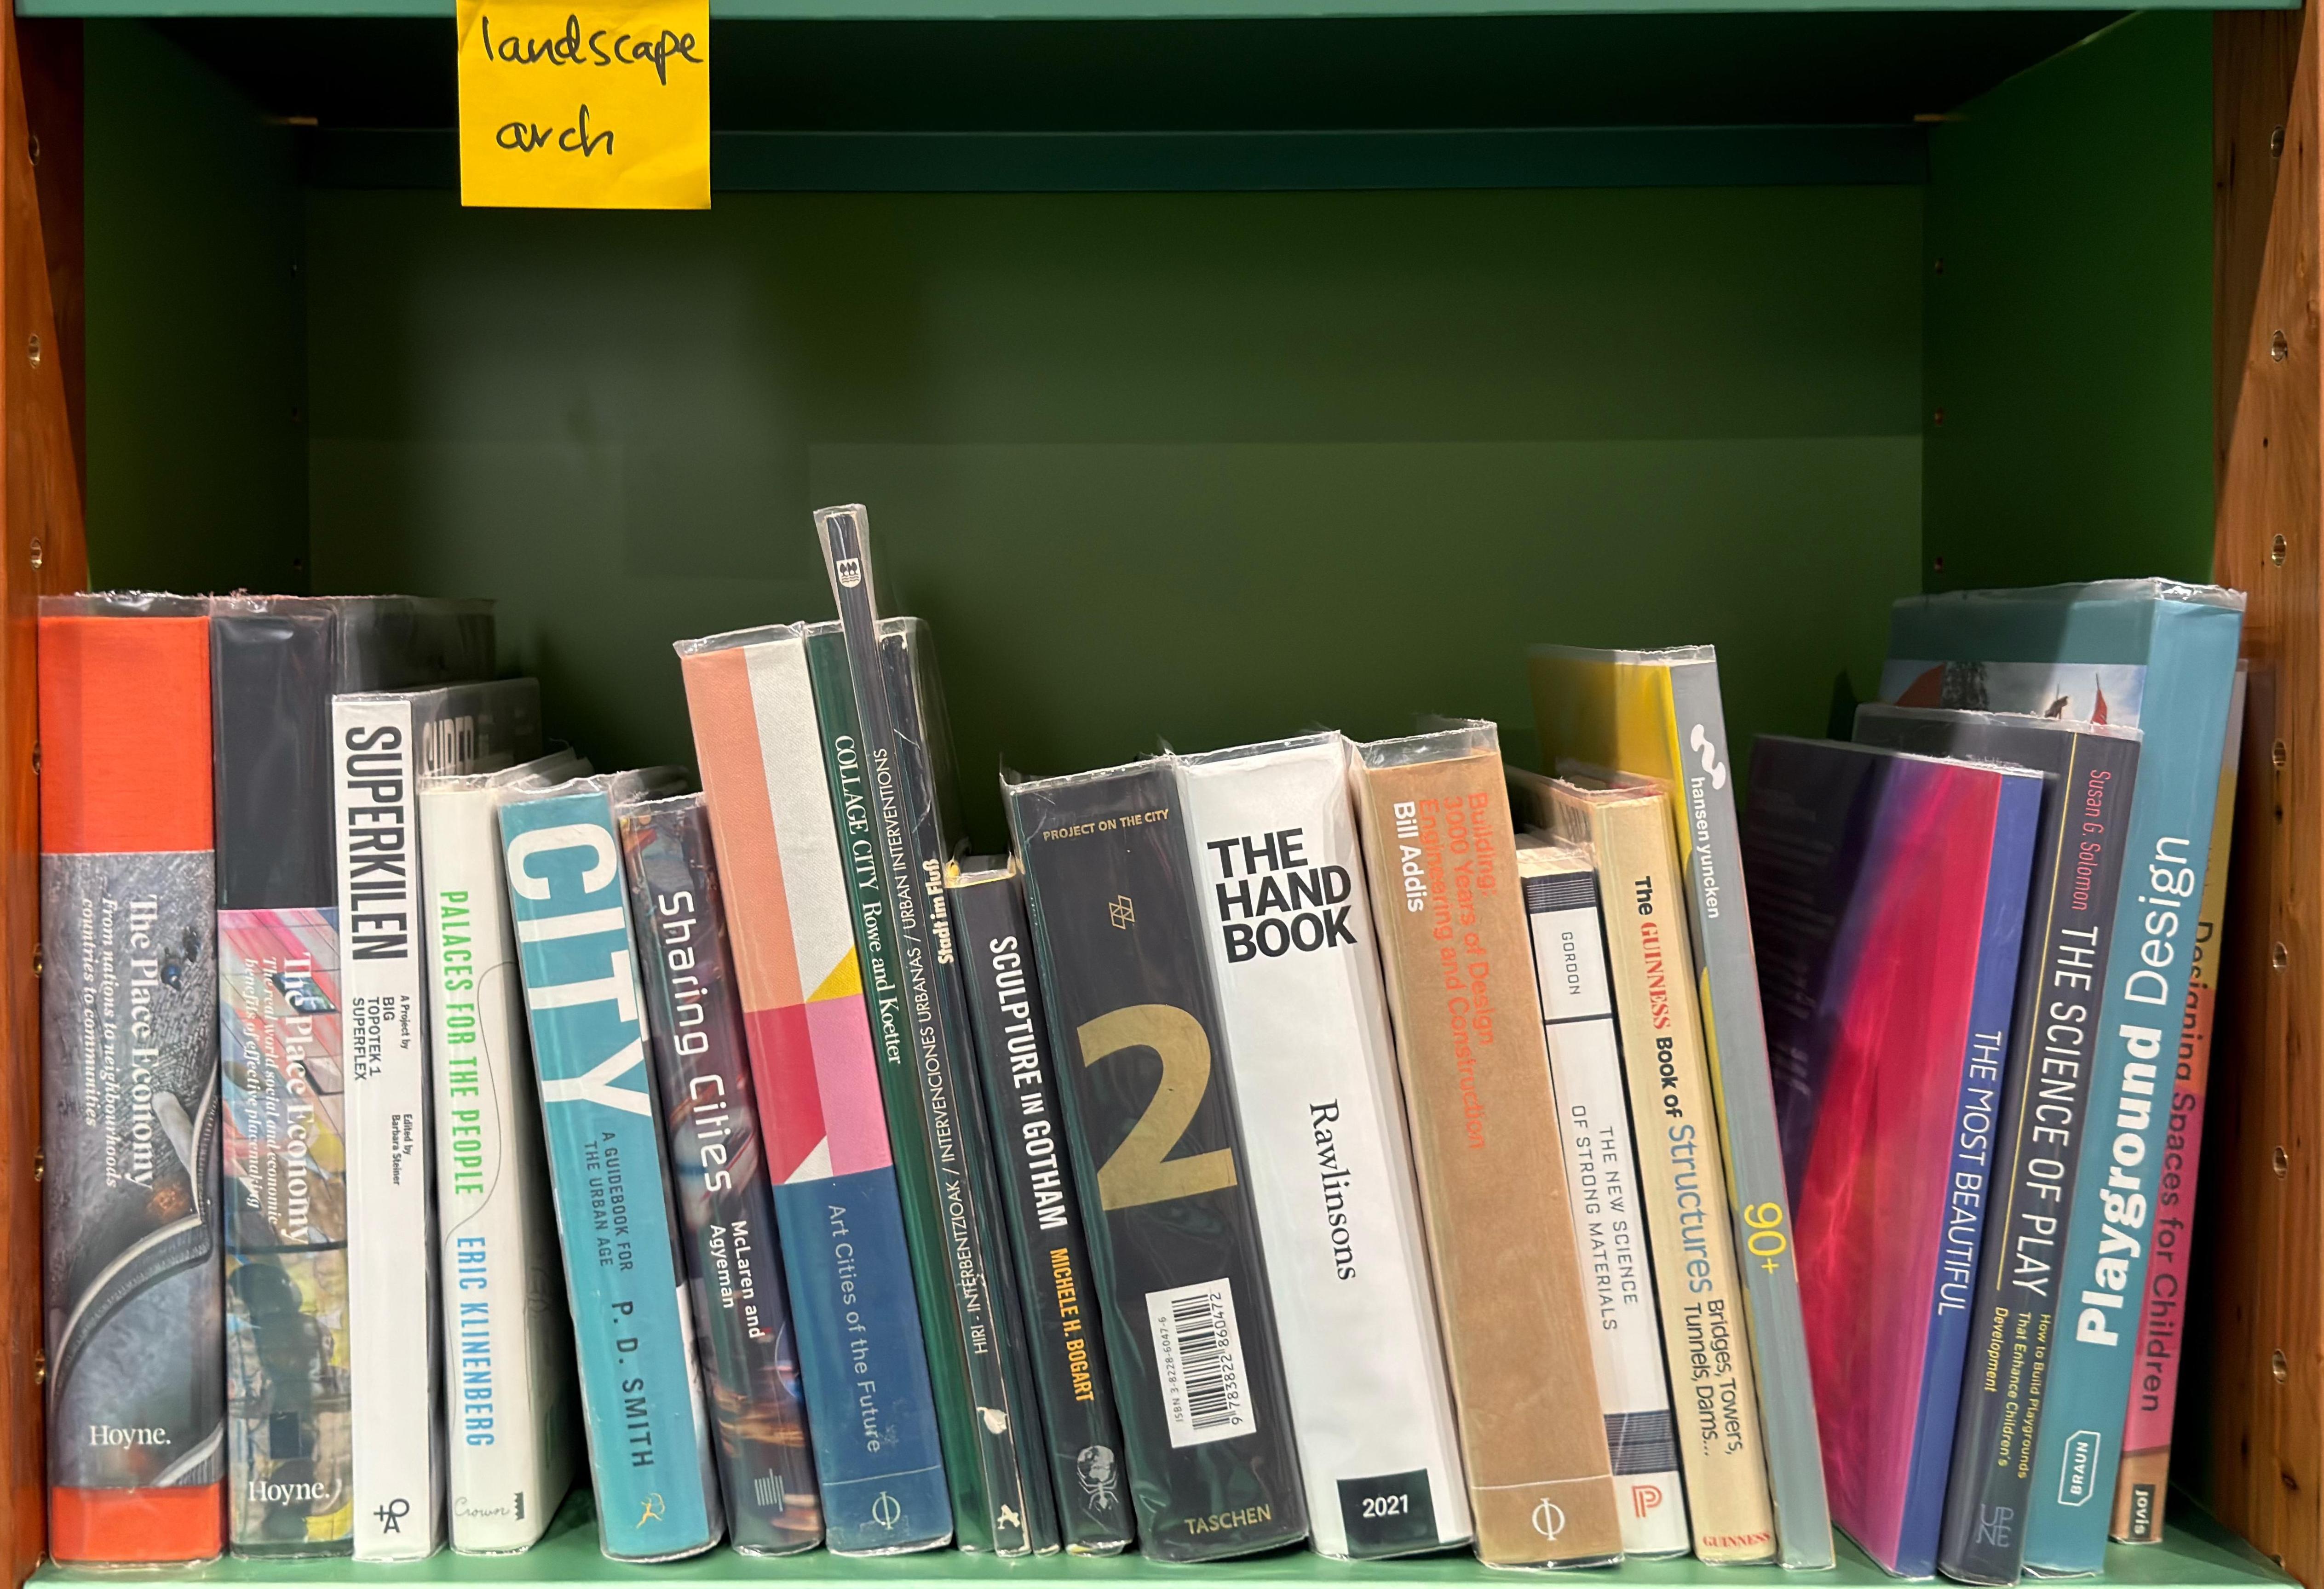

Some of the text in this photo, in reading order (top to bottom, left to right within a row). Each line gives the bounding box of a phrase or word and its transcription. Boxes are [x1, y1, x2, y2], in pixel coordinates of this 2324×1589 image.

[483, 14, 703, 86] landscape
[496, 104, 614, 157] arch
[345, 726, 408, 960] SUPERKILEN
[1043, 809, 1169, 841] PROJECT ON THE CITY
[1207, 828, 1308, 878] THE
[1215, 865, 1351, 922] HAND
[1394, 801, 1427, 912] Bill Addis
[1467, 792, 1497, 896] Building:
[1691, 776, 1720, 919] hansen yuncken
[2071, 769, 2111, 911] Susan G. Solomon
[506, 823, 652, 1117] CITY
[835, 735, 901, 1065] COLLAGE CITY Rowe and Koetter
[930, 896, 947, 919] im
[932, 921, 954, 964] Stadt
[1223, 905, 1358, 963] BOOK
[1443, 796, 1496, 1045] 3000 Years of Design
[1561, 932, 1581, 995] GORDON
[82, 898, 101, 1127] countries communities
[100, 897, 122, 1188] From nations neighbourhoods
[125, 894, 159, 1190] The Place Economy
[353, 998, 367, 1081] SUPERFLEX
[368, 997, 381, 1062] TOPOTEK
[383, 997, 395, 1021] BIG
[400, 1004, 411, 1050] Project by
[440, 891, 483, 1195] PALACES FOR THE PEOPLE
[658, 890, 732, 1192] Sharing Cities
[1418, 798, 1486, 1149] Engineering and Construction
[242, 958, 263, 1208] benefits of effective placemaking
[263, 957, 282, 1225] The real world social and economic
[281, 952, 314, 1245] The Place Economy
[874, 748, 988, 1354] HIRI INTERBENTZIOAK INTERVENCIONES URBANAS URBAN INTERVENTIONS
[989, 935, 1068, 1231] SCULPTURE IN GOTHAM
[1077, 1004, 1237, 1211] 2
[1635, 876, 1713, 1294] The GUINNESS Book of Structures
[2012, 926, 2098, 1297] THE SCIENCE OF PLAY
[2076, 836, 2195, 1346] Playground Design
[392, 1115, 401, 1150] Barbara
[403, 1113, 413, 1155] Edited by
[1309, 1098, 1356, 1280] Rawlinsons
[1938, 1031, 2002, 1316] THE MOST BEAUTIFUL
[2162, 1093, 2196, 1206] Spaces
[584, 1141, 614, 1267] THE URBAN AGE
[604, 1147, 633, 1272] GUIDEBOOK FOR
[709, 1225, 734, 1309] Agyeman
[1572, 1105, 1617, 1330] OF STRONG MATERIALS
[1599, 1126, 1638, 1304] THE NEW SCIENCE
[1744, 1201, 1787, 1274] 90+
[2157, 1217, 2184, 1264] for
[457, 1237, 495, 1446] ERIC KLINENBERG
[731, 1220, 765, 1339] McLaren and
[828, 1205, 880, 1453] Art Cities of the Future
[1050, 1248, 1095, 1402] MICHELE H. BOGART
[1984, 1306, 2008, 1393] Development
[2140, 1273, 2178, 1411] Children
[90, 1425, 172, 1450] Hoyne.
[611, 1301, 655, 1468] P. D. SMITH
[1158, 1316, 1184, 1423] ISBN 3-8228-6047-6
[1683, 1302, 1718, 1457] Tunnels, Dams...
[1708, 1299, 1743, 1455] Bridges, Towers,
[1998, 1312, 2031, 1467] That Enhance Children's
[2018, 1313, 2051, 1480] How Build Playgrounds
[248, 1480, 330, 1505] Hoyne.
[1185, 1504, 1271, 1535] TASCHEN
[1362, 1494, 1409, 1518] 2021
[2070, 1441, 2089, 1495] BRAUN
[1703, 1531, 1772, 1548] GUINNESS
